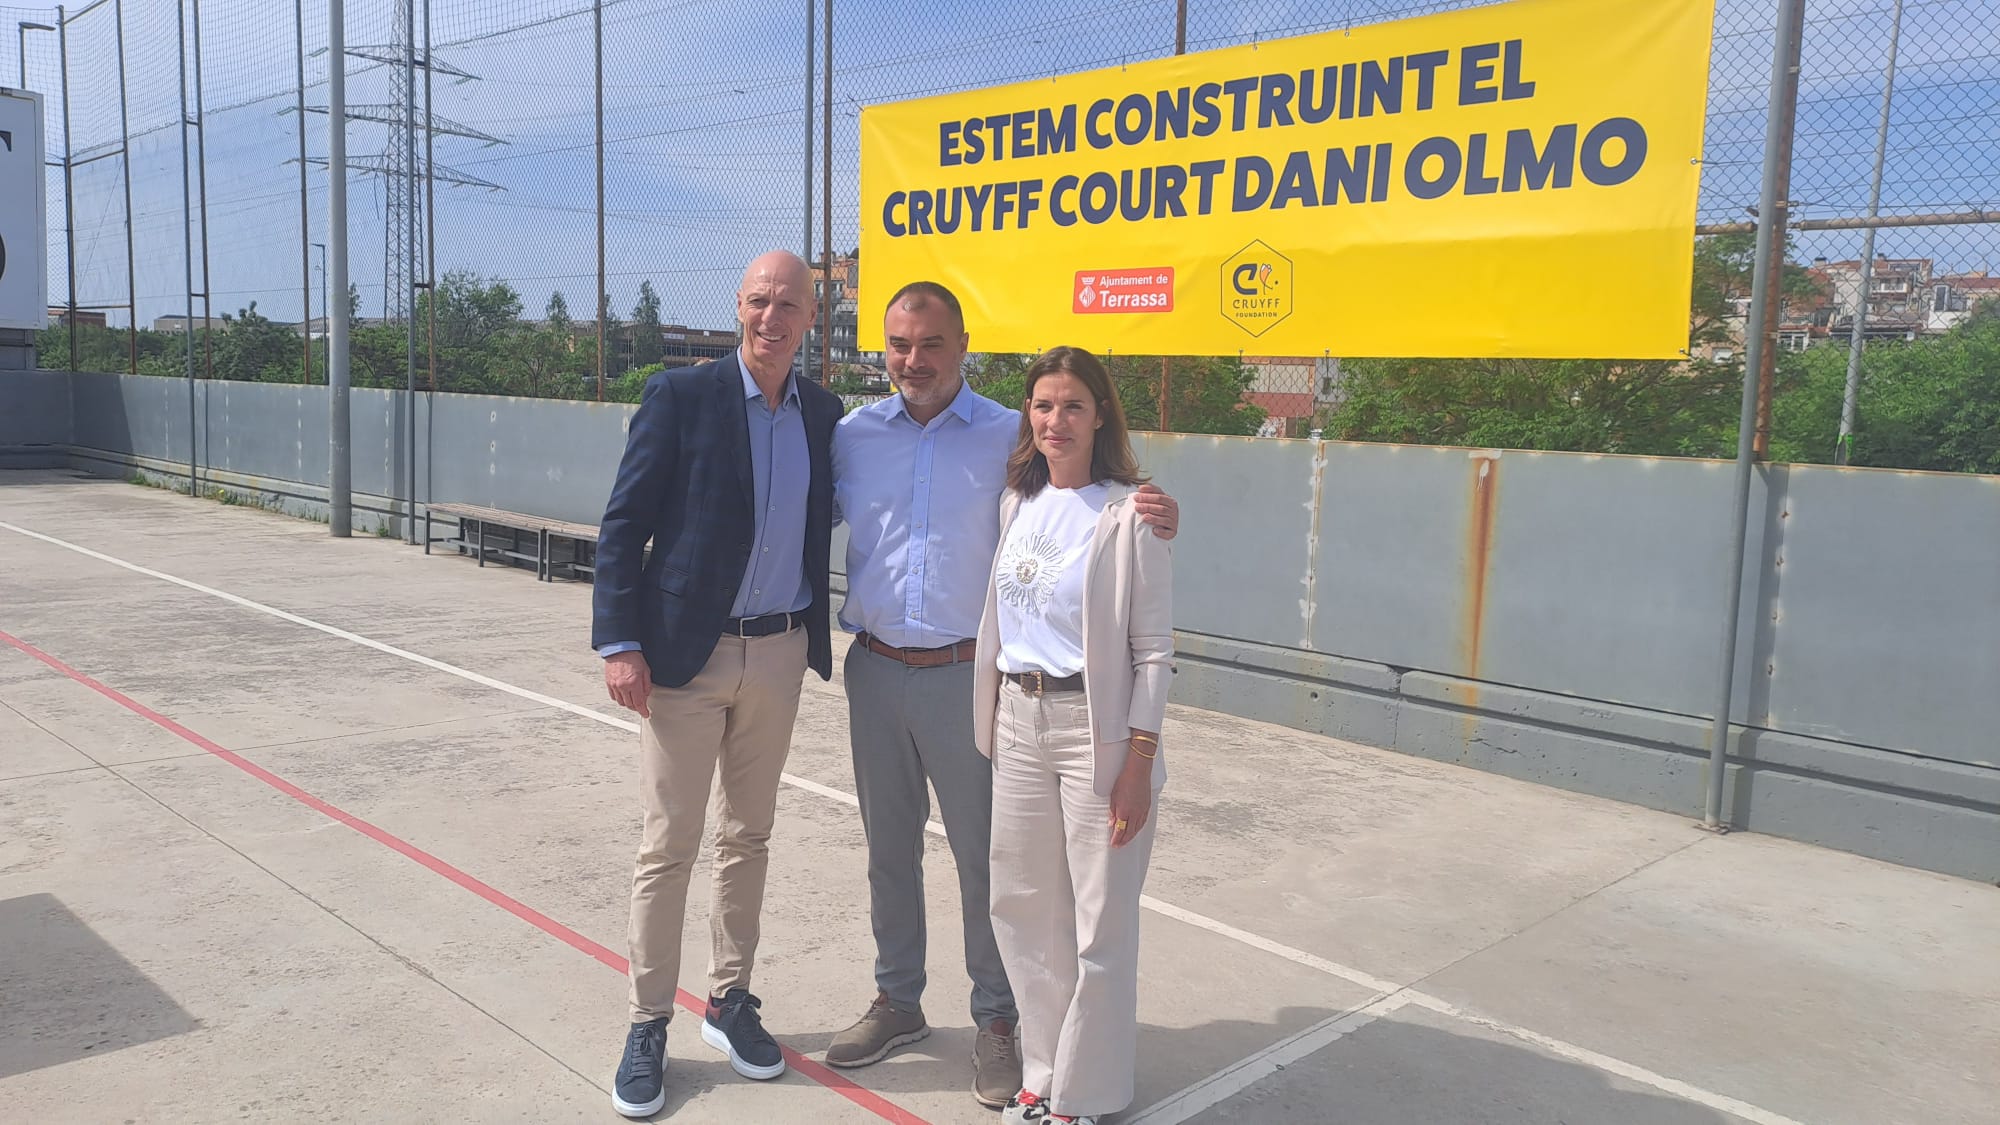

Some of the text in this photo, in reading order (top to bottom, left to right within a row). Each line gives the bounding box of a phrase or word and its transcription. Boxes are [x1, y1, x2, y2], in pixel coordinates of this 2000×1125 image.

[939, 39, 1536, 167] ESTEM CONSTRUINT EL
[882, 117, 1648, 238] CRUYFF COURT DANI OLMO
[1099, 273, 1169, 289] Ajuntament de
[1099, 290, 1168, 308] Terrassa
[1232, 298, 1281, 309] CRUYFF
